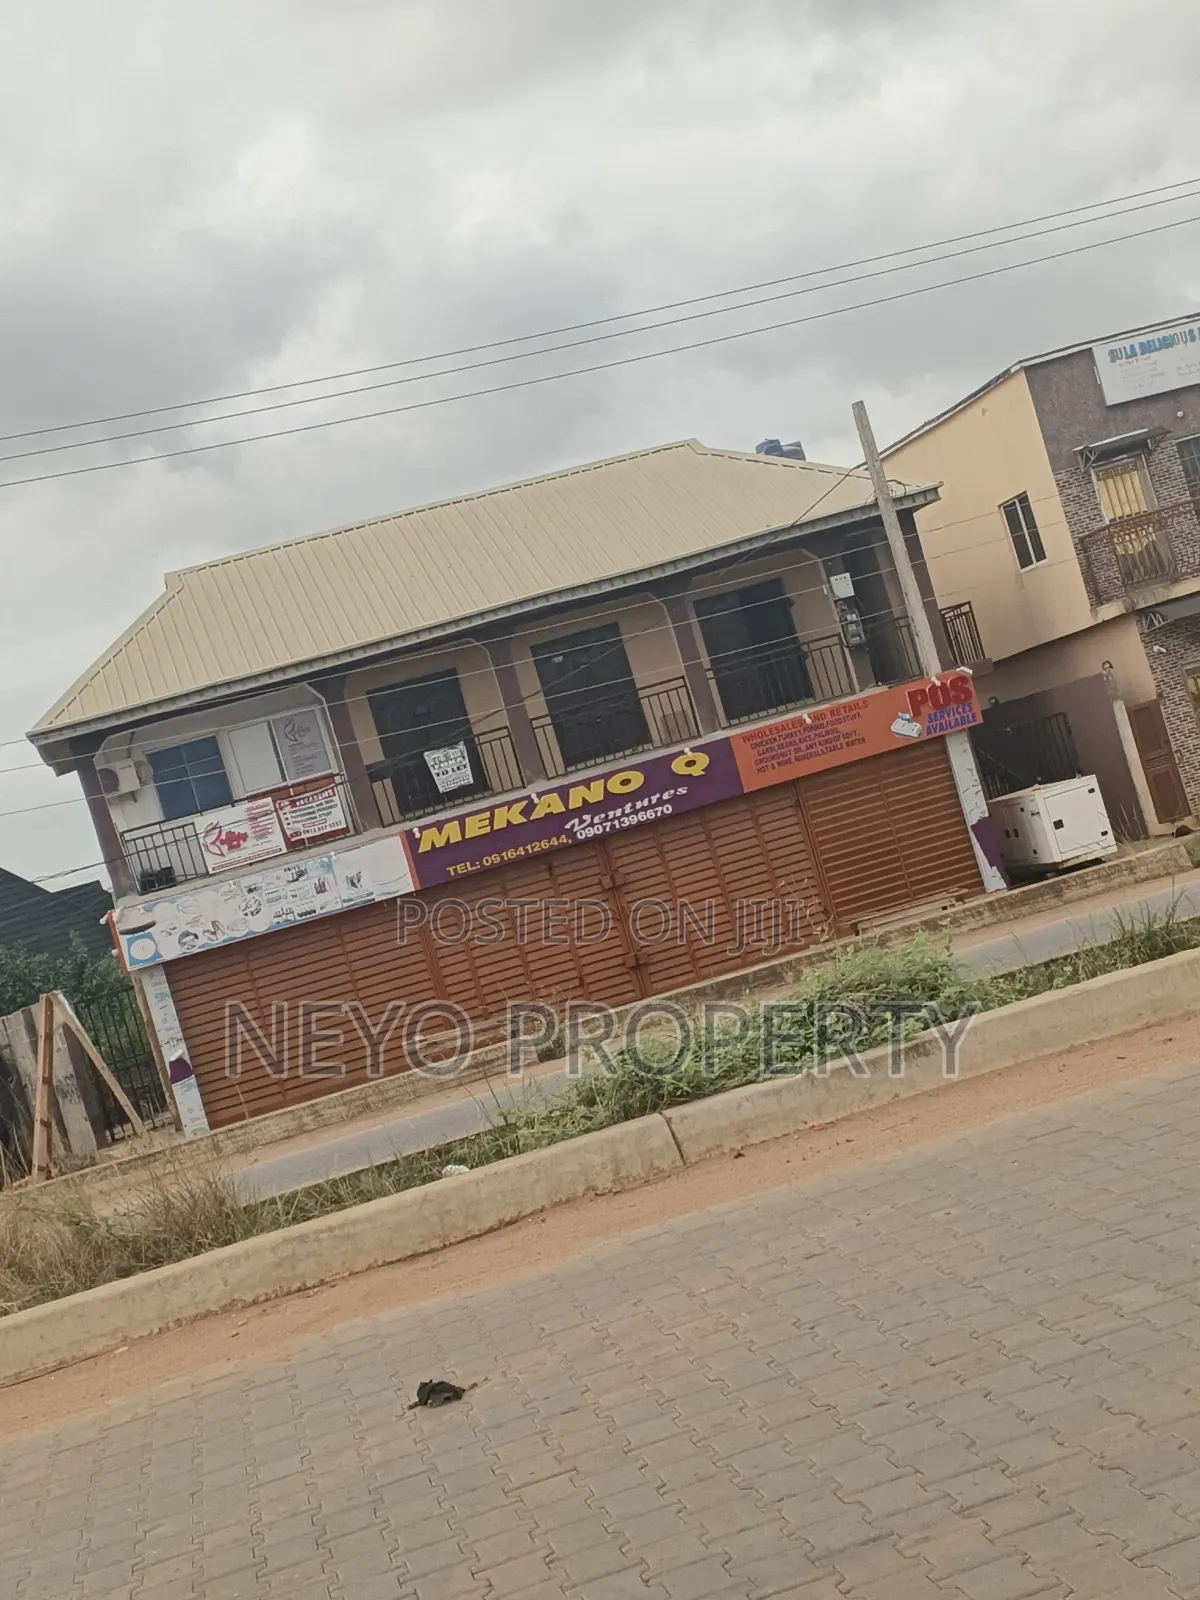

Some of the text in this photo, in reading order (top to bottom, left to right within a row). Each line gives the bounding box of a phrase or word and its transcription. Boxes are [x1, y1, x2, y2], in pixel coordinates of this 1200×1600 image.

[905, 675, 973, 719] POS
[928, 702, 973, 723] SERVICES
[741, 720, 804, 743] WHOLESALES
[829, 700, 868, 718] RETAILS
[926, 712, 977, 736] AVAILABLE
[756, 764, 769, 774] HOT
[845, 737, 866, 748] WATER
[418, 752, 710, 854] MEKANO Q
[564, 786, 688, 832] Ventures
[446, 804, 673, 877] TEL: 0916412644, 09071396670
